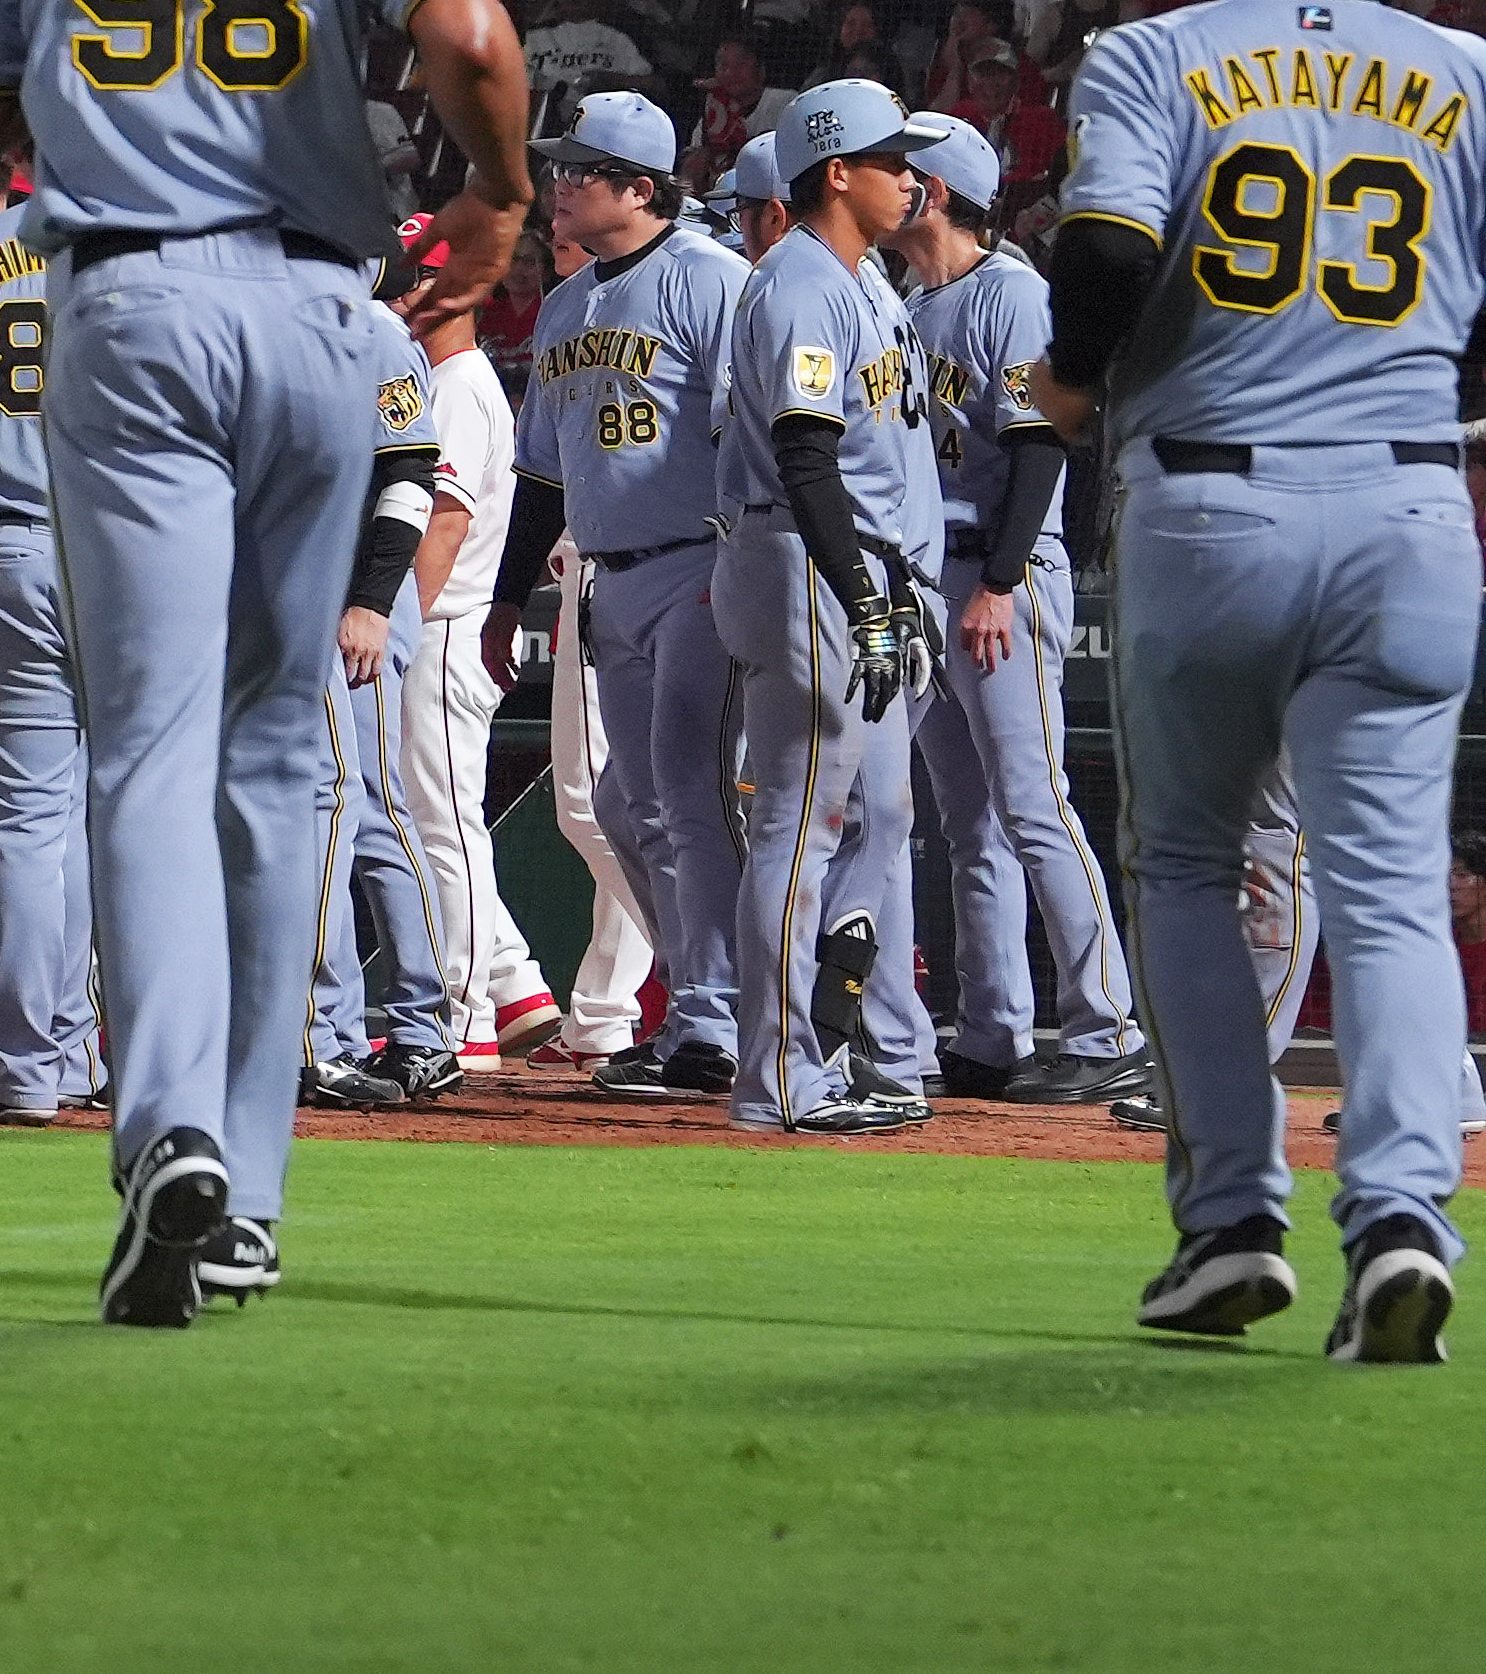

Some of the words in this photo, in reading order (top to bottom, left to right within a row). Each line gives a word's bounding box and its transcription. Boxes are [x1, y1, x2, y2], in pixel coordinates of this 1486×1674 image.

[1187, 48, 1468, 153] KATAYAMA
[1192, 141, 1433, 328] 93
[598, 398, 659, 450] 88
